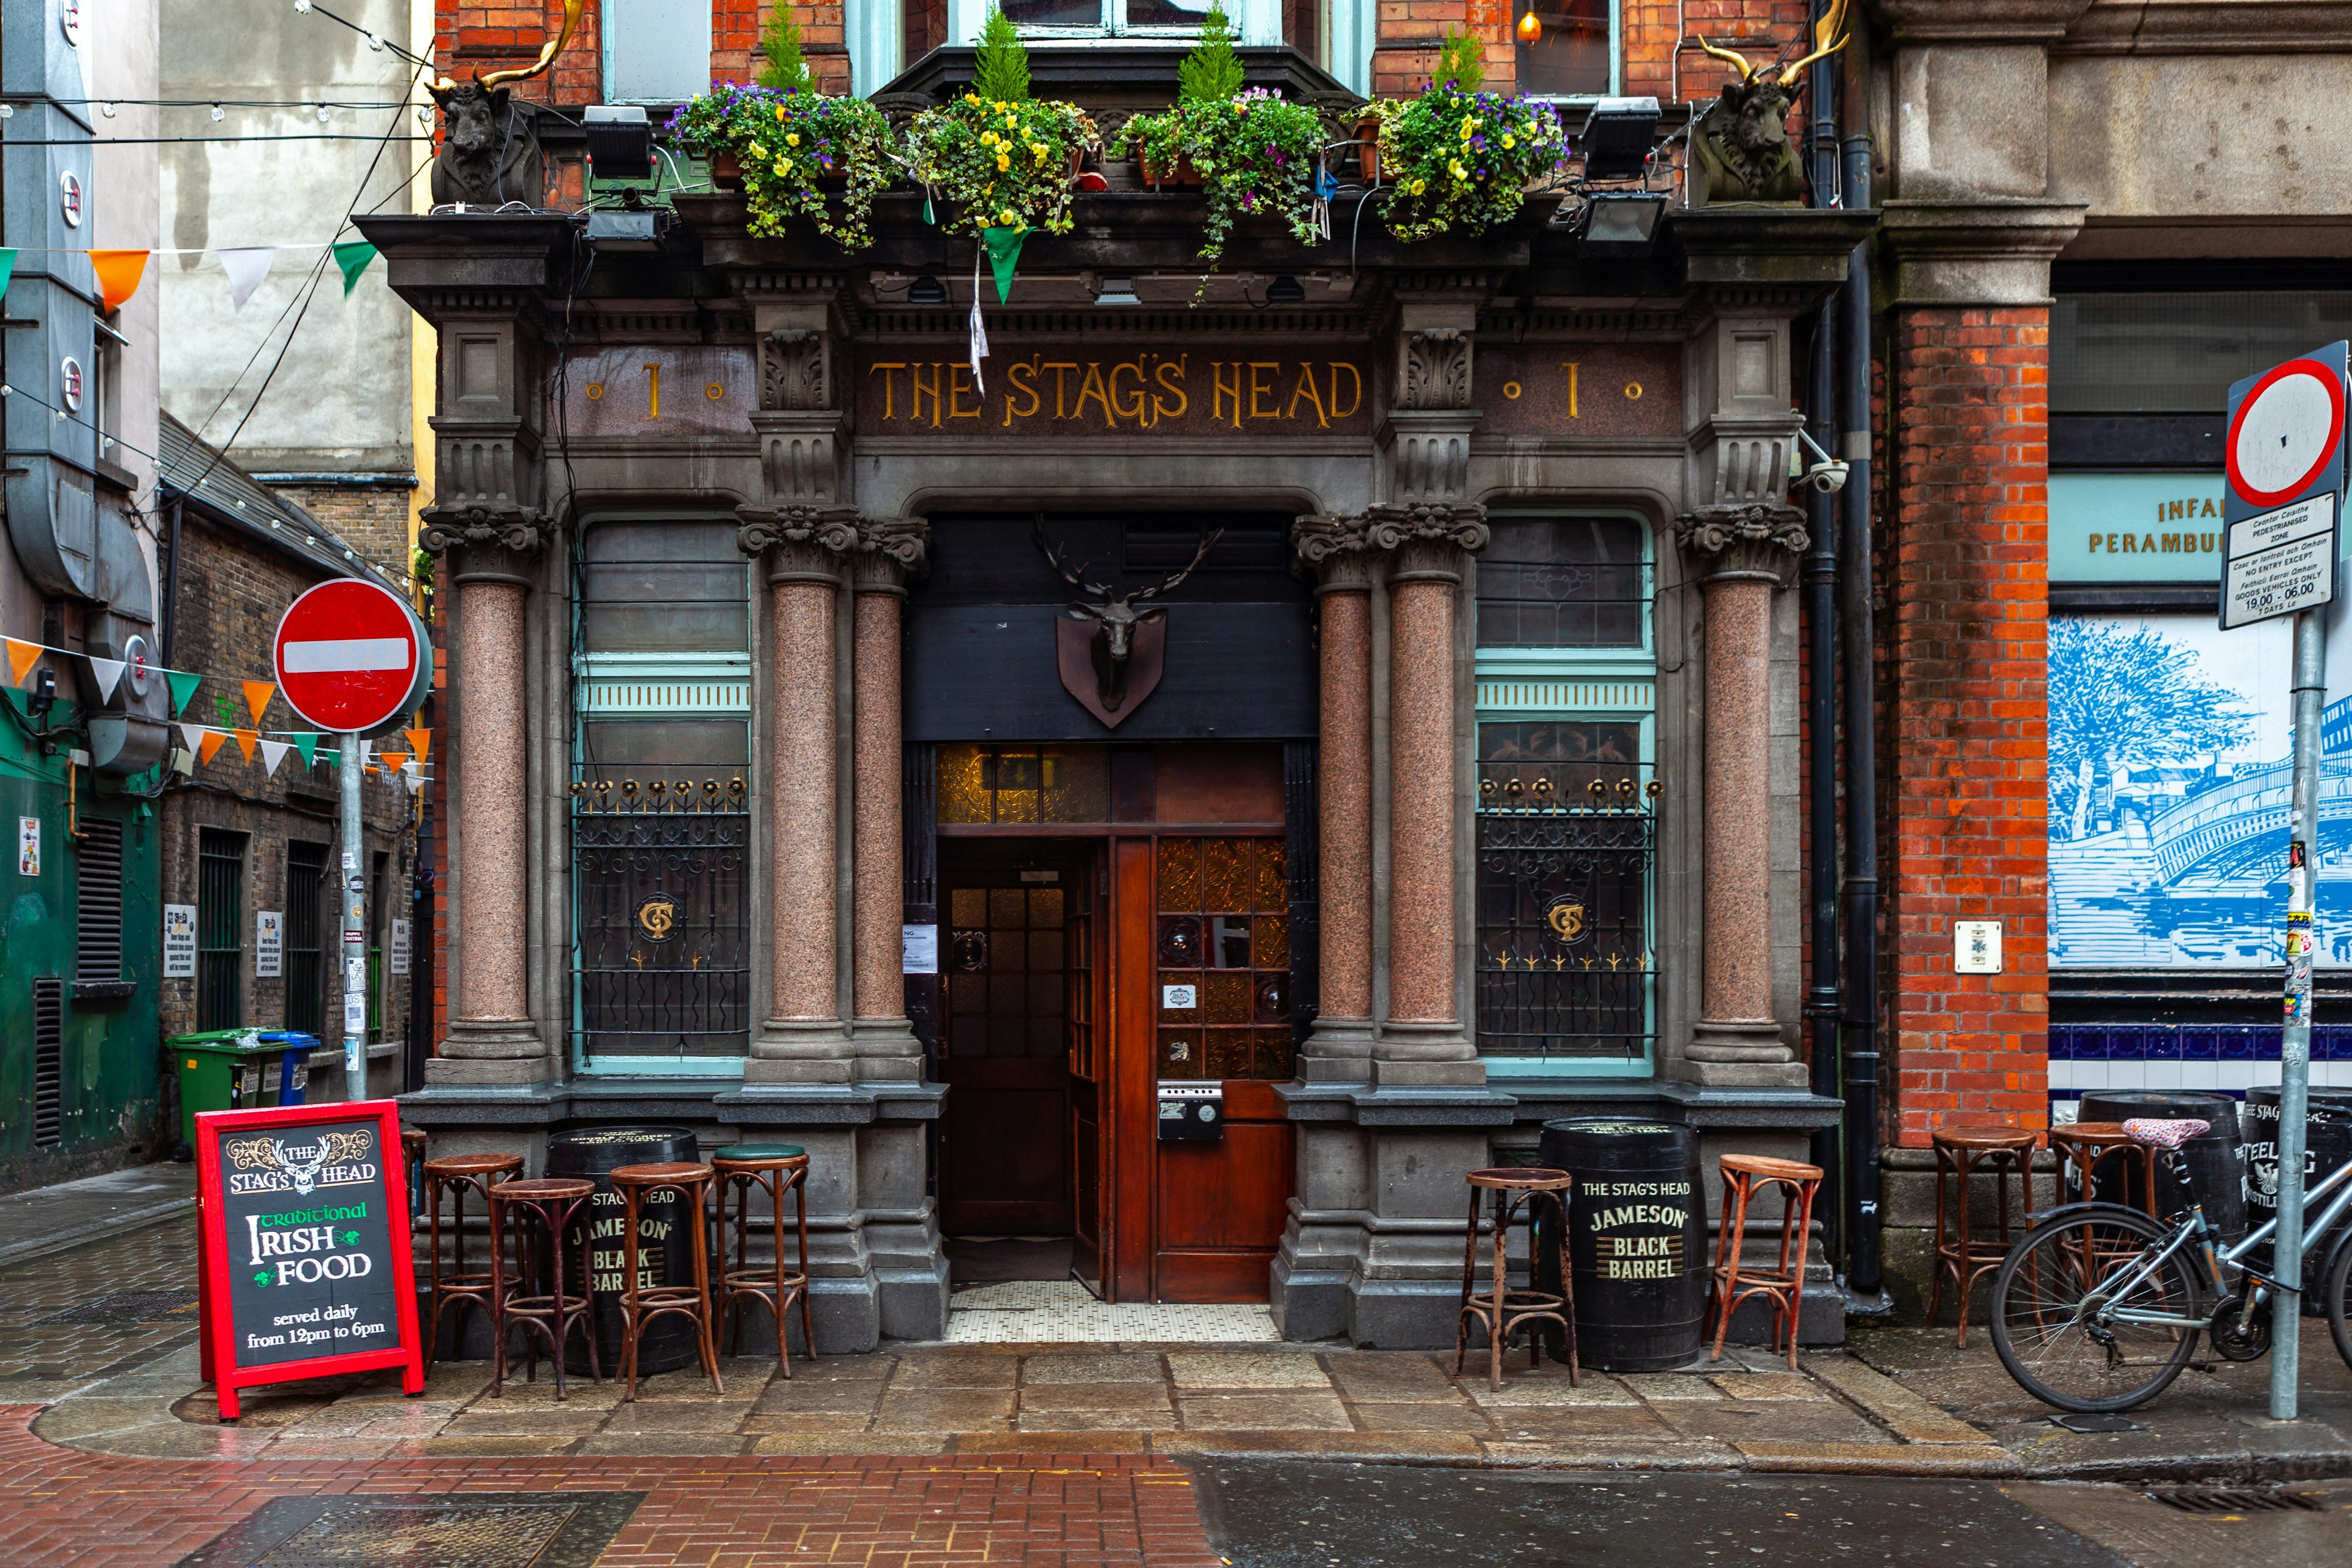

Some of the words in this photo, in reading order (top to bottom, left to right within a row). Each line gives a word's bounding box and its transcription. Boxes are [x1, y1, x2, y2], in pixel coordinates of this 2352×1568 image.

[869, 363, 981, 429] THE
[1002, 353, 1189, 429] STAG'S
[1209, 361, 1362, 429] HEAD
[2158, 499, 2225, 522] INFA
[2253, 515, 2278, 528] Ceantar
[2253, 515, 2308, 538] PEDESTRIANISED
[2271, 532, 2289, 543] ZONE
[2259, 562, 2282, 574] ENTRY
[2285, 551, 2313, 566] EXCEPT
[2235, 589, 2260, 601] GOODS
[2262, 578, 2298, 594] VEHICLES
[2301, 571, 2322, 583] ONLY
[2245, 594, 2272, 610] 19.00
[2285, 582, 2314, 600] 06.00
[2264, 605, 2283, 614] DAYS
[2244, 1104, 2256, 1118] THE
[285, 1147, 317, 1160] THE
[322, 1163, 376, 1183] HEAD
[1582, 1183, 1608, 1196] THE
[1612, 1183, 1658, 1196] STAG'S
[1660, 1183, 1691, 1195] HEAD
[1590, 1205, 1686, 1231] JAMESON
[245, 1215, 336, 1265] IRISH
[1614, 1237, 1670, 1256] BLACK
[276, 1253, 372, 1286] FOOD
[594, 1248, 649, 1269] BLAK
[1609, 1259, 1676, 1279] BARREL
[593, 1270, 656, 1291] BAREL
[273, 1308, 320, 1327] served
[323, 1303, 358, 1322] daily
[247, 1333, 285, 1349] from
[290, 1327, 331, 1346] 12pm
[334, 1325, 347, 1338] to
[352, 1322, 385, 1341] 6pm
